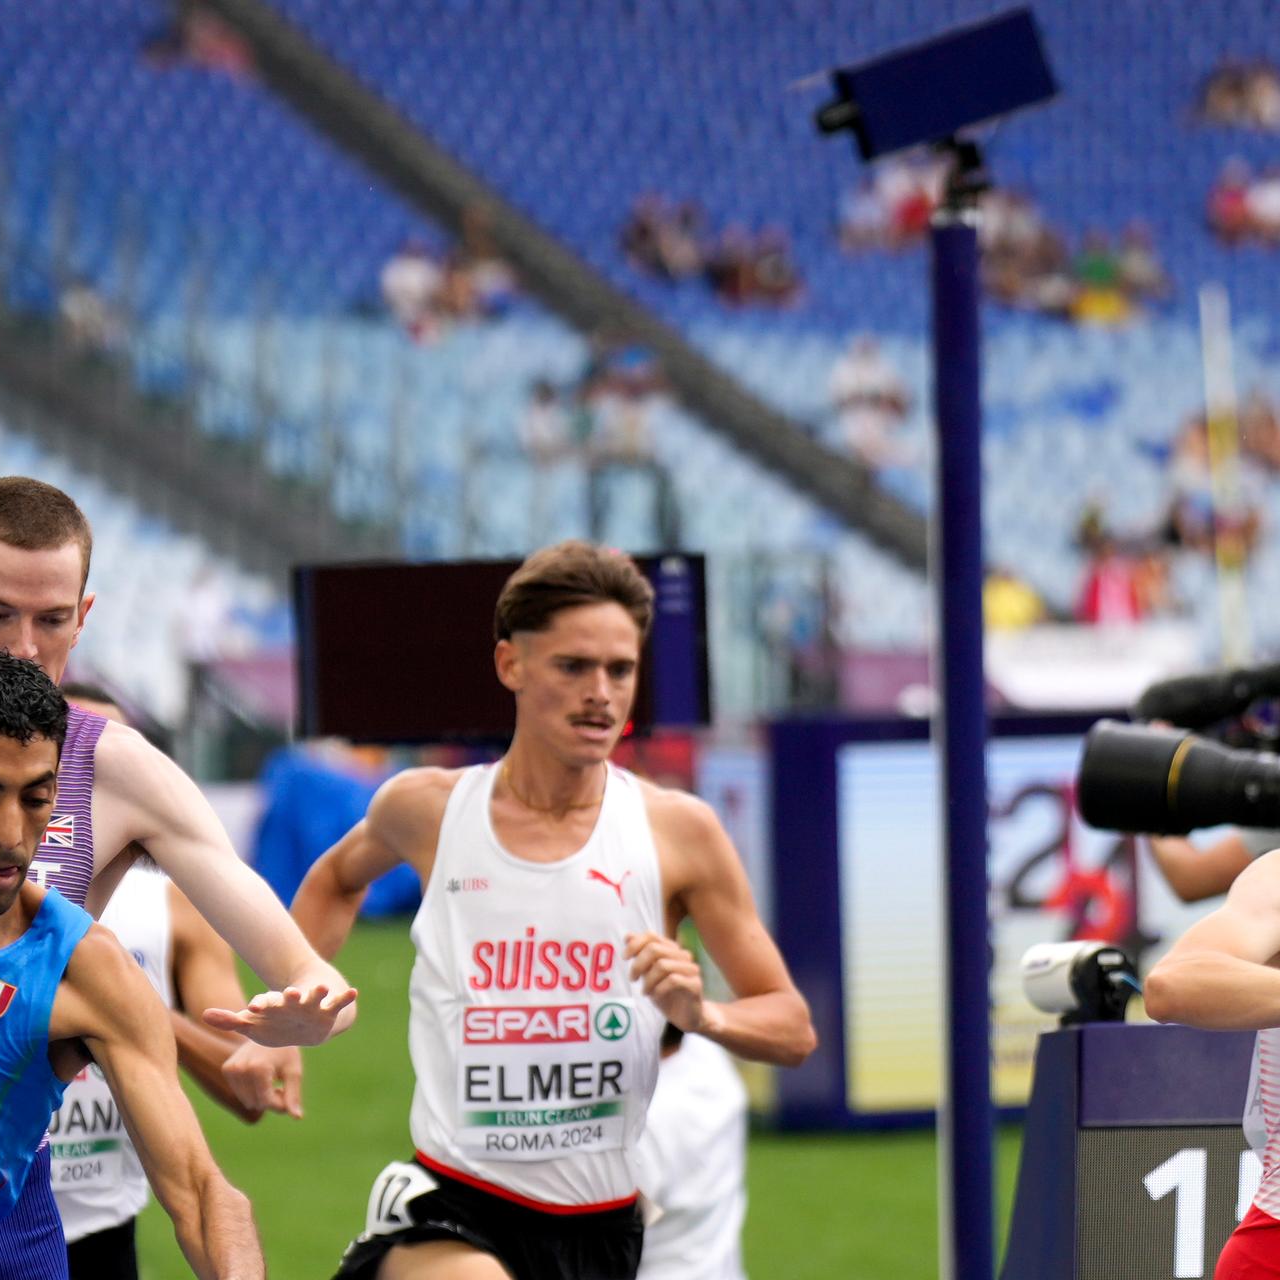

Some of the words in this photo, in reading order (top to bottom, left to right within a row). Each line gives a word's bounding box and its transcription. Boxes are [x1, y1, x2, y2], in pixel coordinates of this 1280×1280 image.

[469, 925, 615, 993] suisse
[465, 1008, 588, 1041] SPAR
[464, 1060, 624, 1102] ELMER
[505, 1111, 543, 1125] RUN
[486, 1130, 554, 1151] ROMA
[560, 1125, 603, 1147] 2024
[378, 1173, 412, 1225] 12
